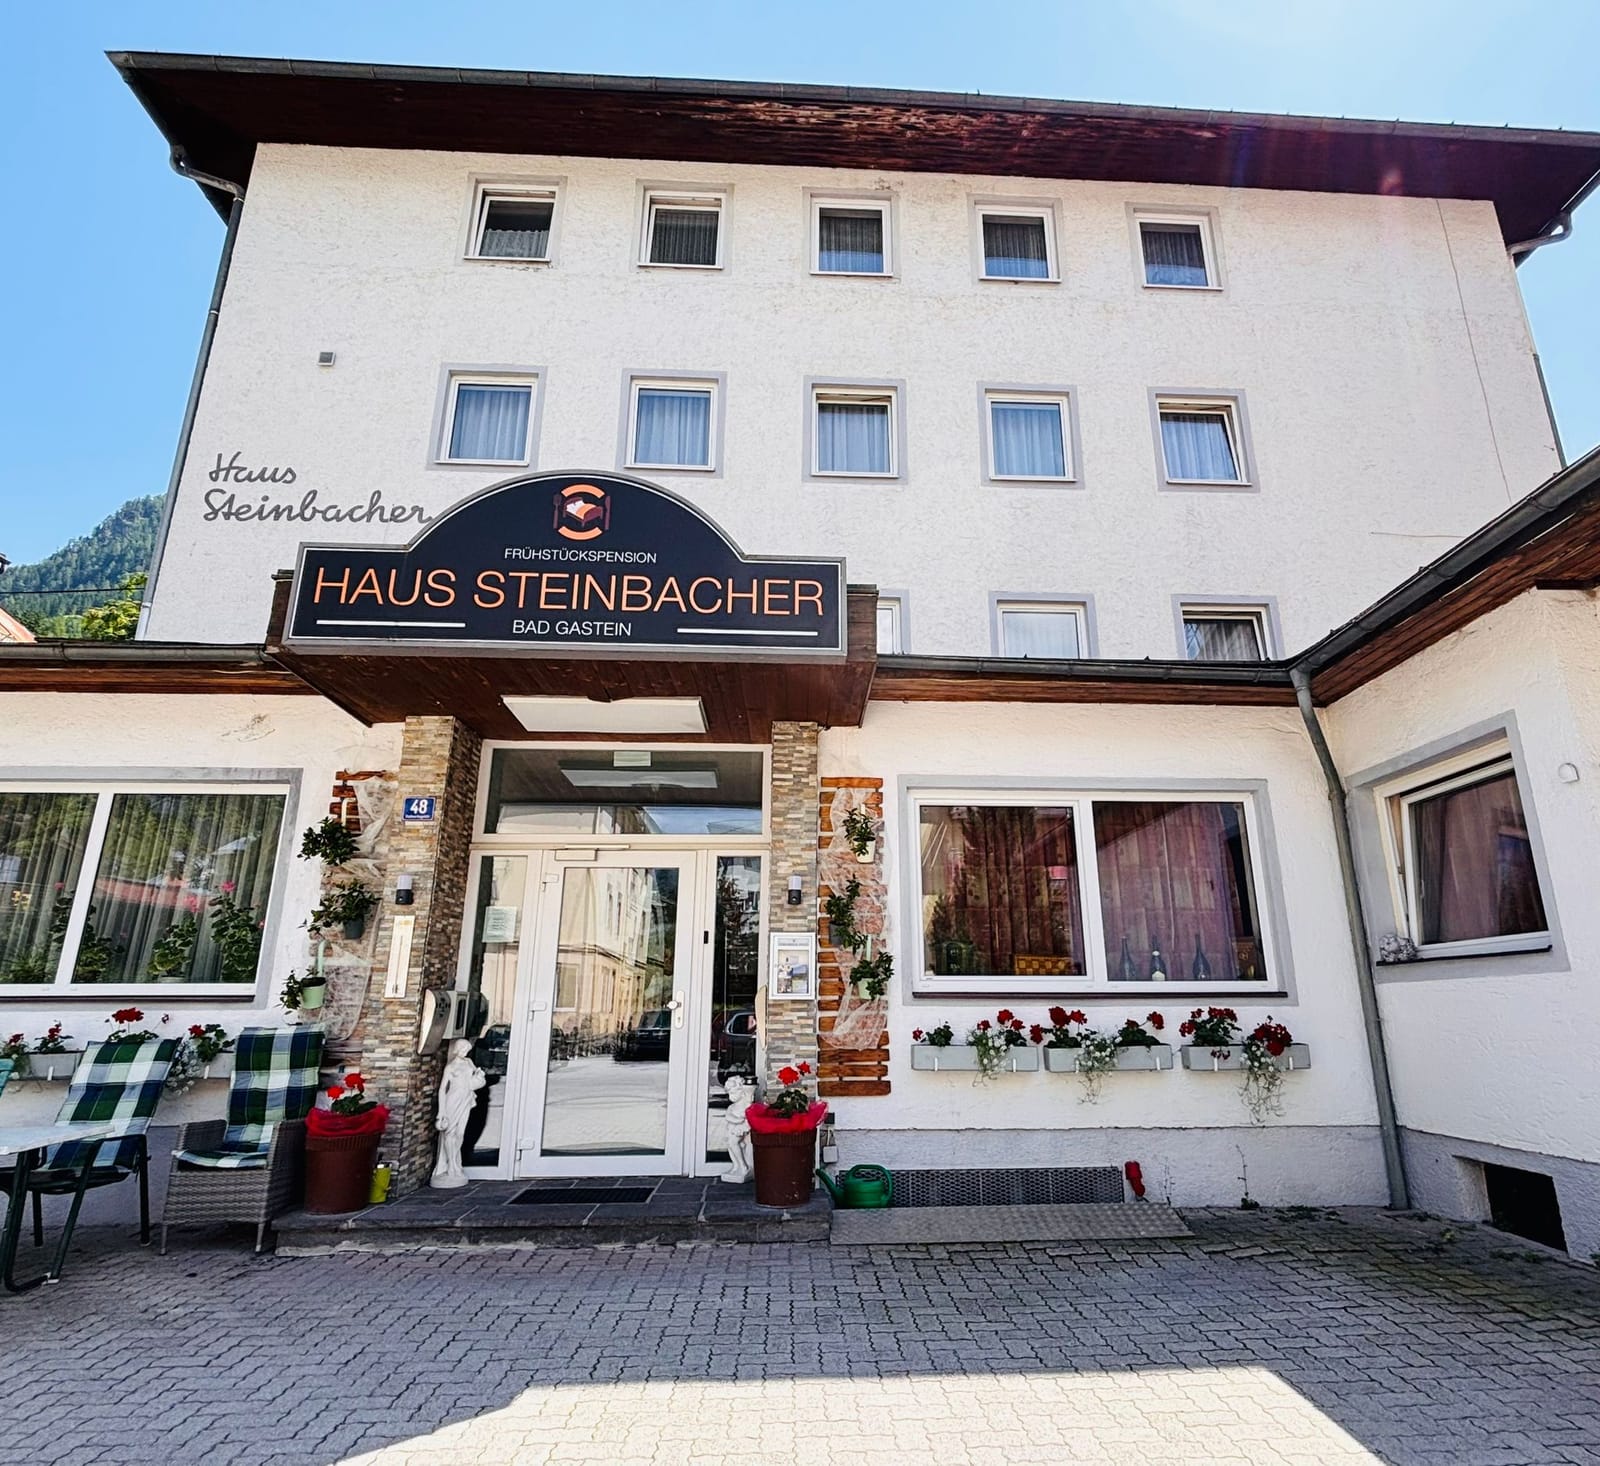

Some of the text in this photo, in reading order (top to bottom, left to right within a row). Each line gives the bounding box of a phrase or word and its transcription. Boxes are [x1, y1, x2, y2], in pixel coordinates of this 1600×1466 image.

[208, 451, 297, 484] Haus
[203, 488, 433, 524] Steinbacher
[504, 546, 657, 564] FRÜHSTÜCKSPENSION
[313, 567, 824, 616] HAUS STEINBACHER
[512, 619, 632, 637] BAD GASTEIN
[410, 799, 428, 815] 48
